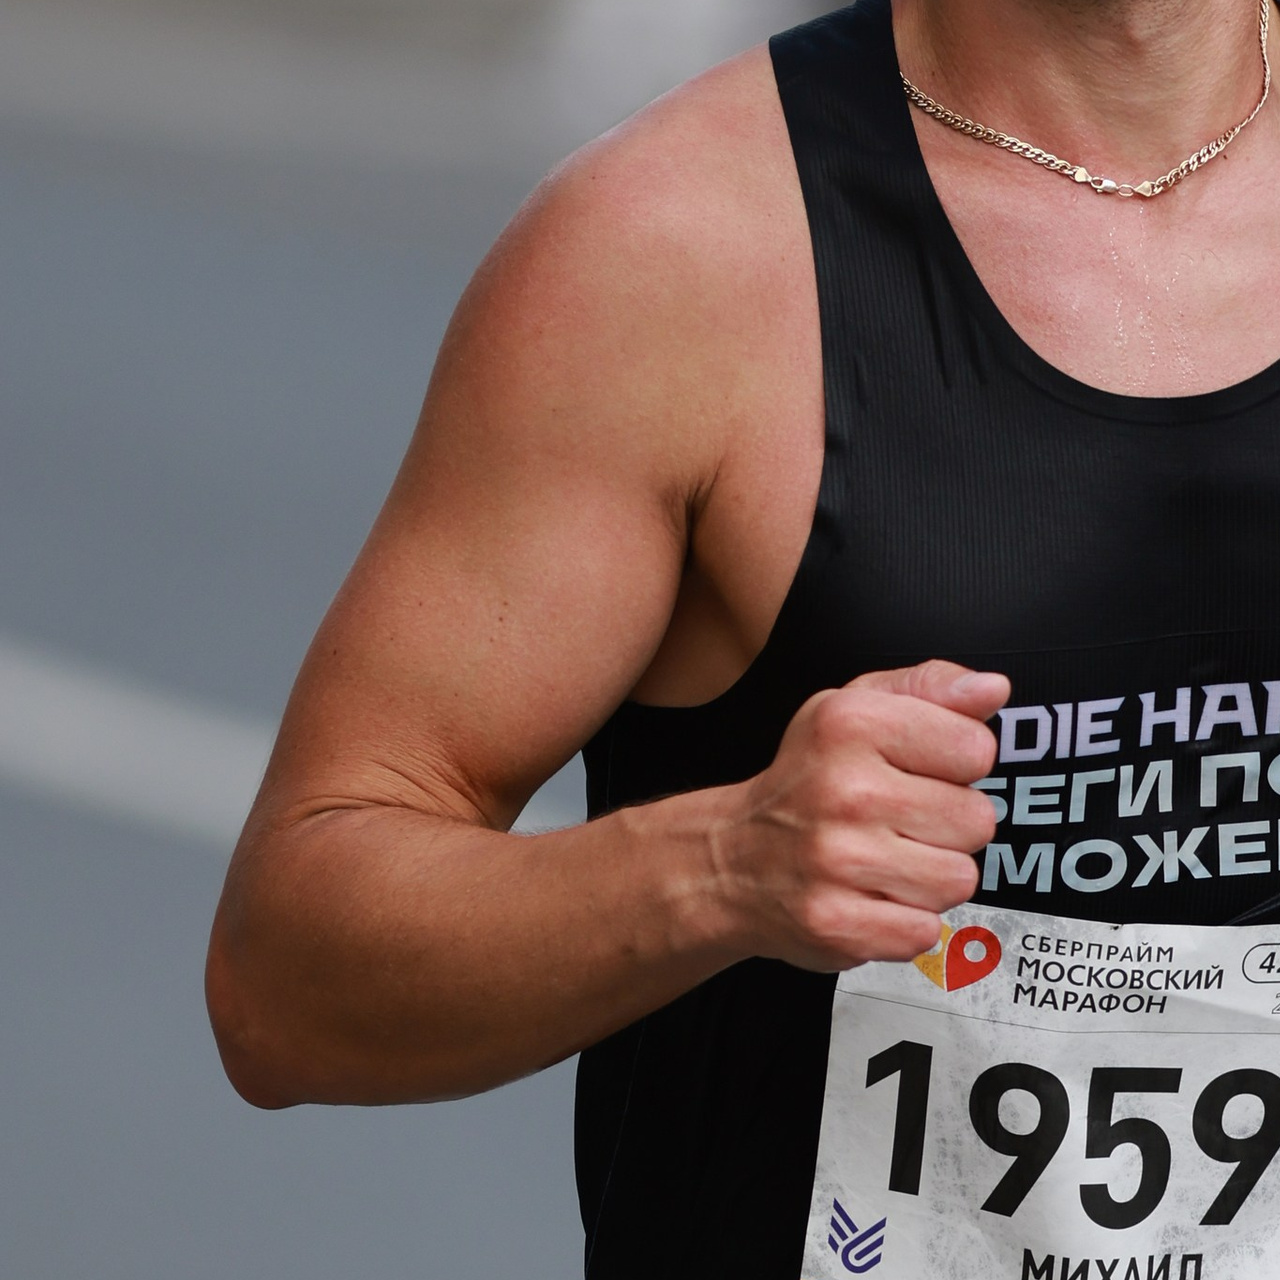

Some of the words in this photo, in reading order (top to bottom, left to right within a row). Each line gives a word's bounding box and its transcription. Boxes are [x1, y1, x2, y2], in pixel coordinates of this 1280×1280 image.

[998, 697, 1125, 763] DIE
[1020, 933, 1175, 963] СБЕРПРАЙМ
[1016, 955, 1224, 991] МОСКОВСКИЙ
[1013, 983, 1168, 1015] МАРАФОН
